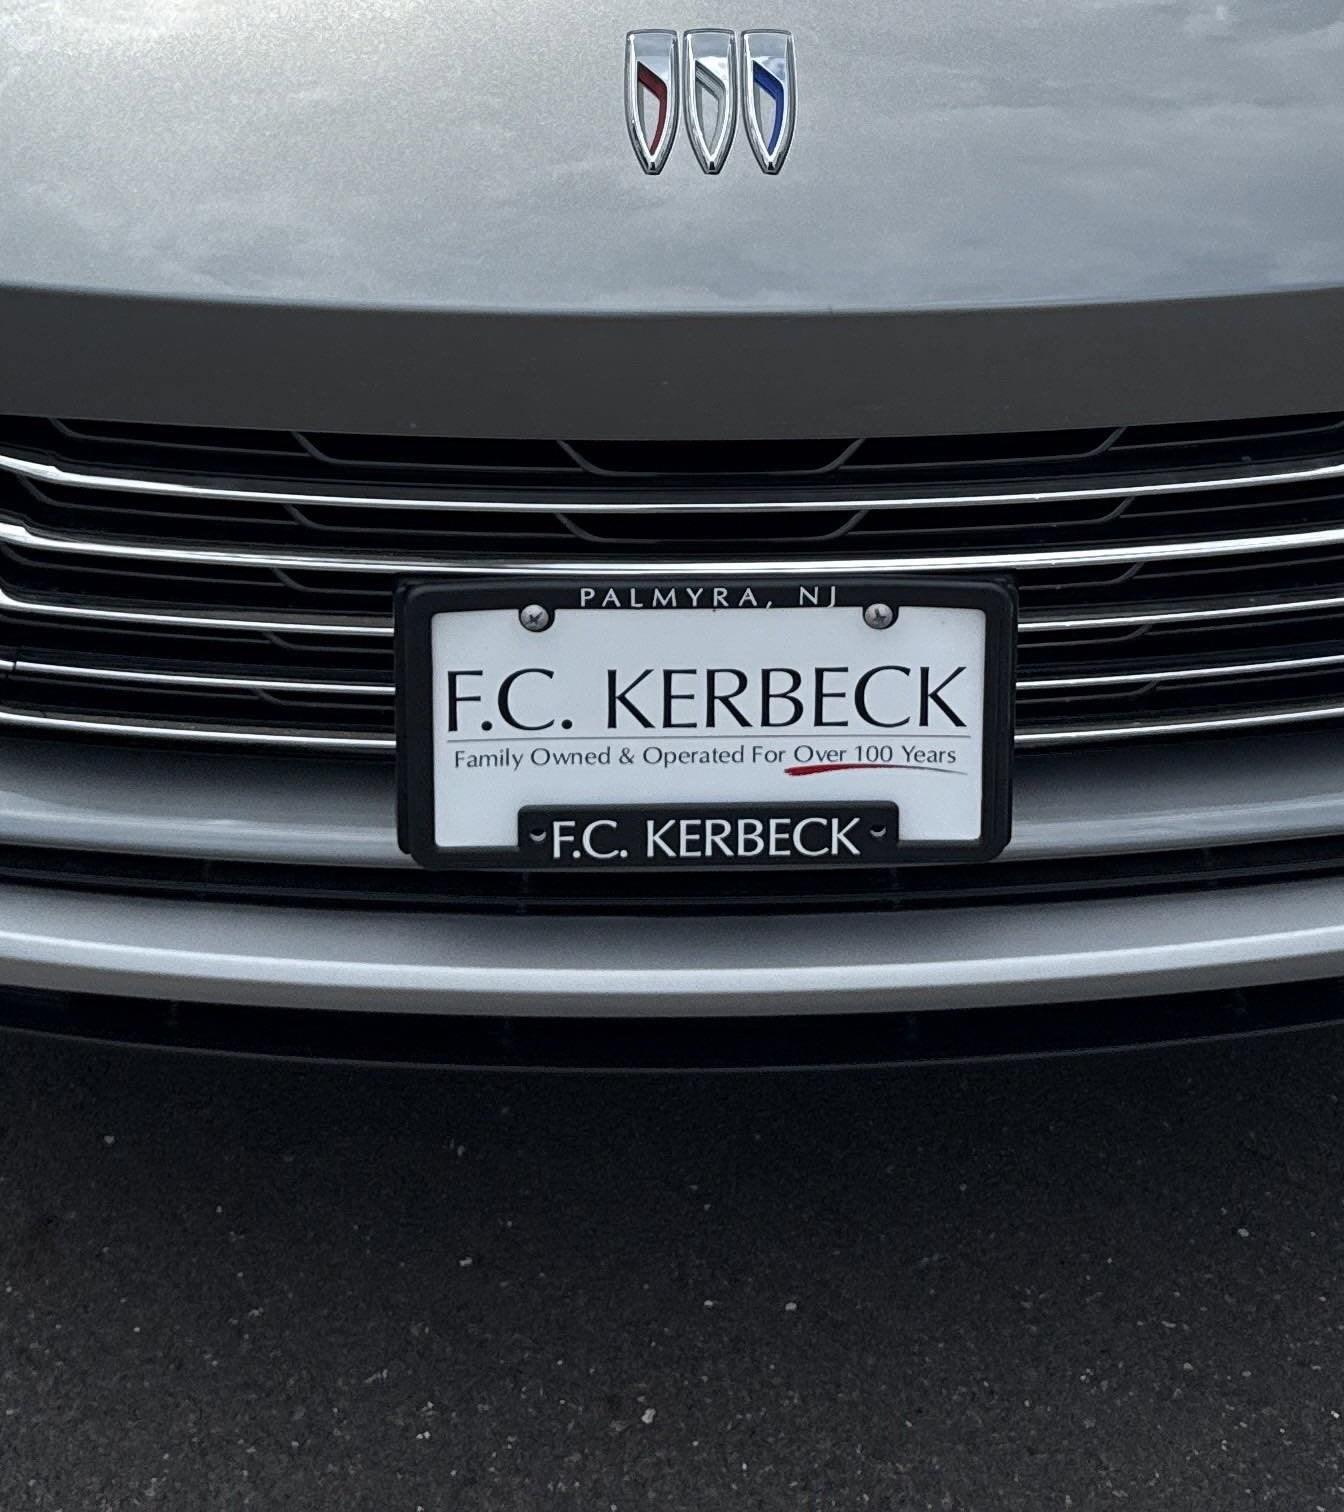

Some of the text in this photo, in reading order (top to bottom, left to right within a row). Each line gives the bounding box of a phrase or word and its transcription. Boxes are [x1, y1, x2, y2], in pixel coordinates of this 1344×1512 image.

[580, 585, 836, 610] PALMYRA, NJ
[447, 665, 967, 732] F.C. KERBECK
[455, 744, 957, 771] Family Owned & Operated For Over 100 Years
[553, 817, 861, 859] F.C. KERBECK
